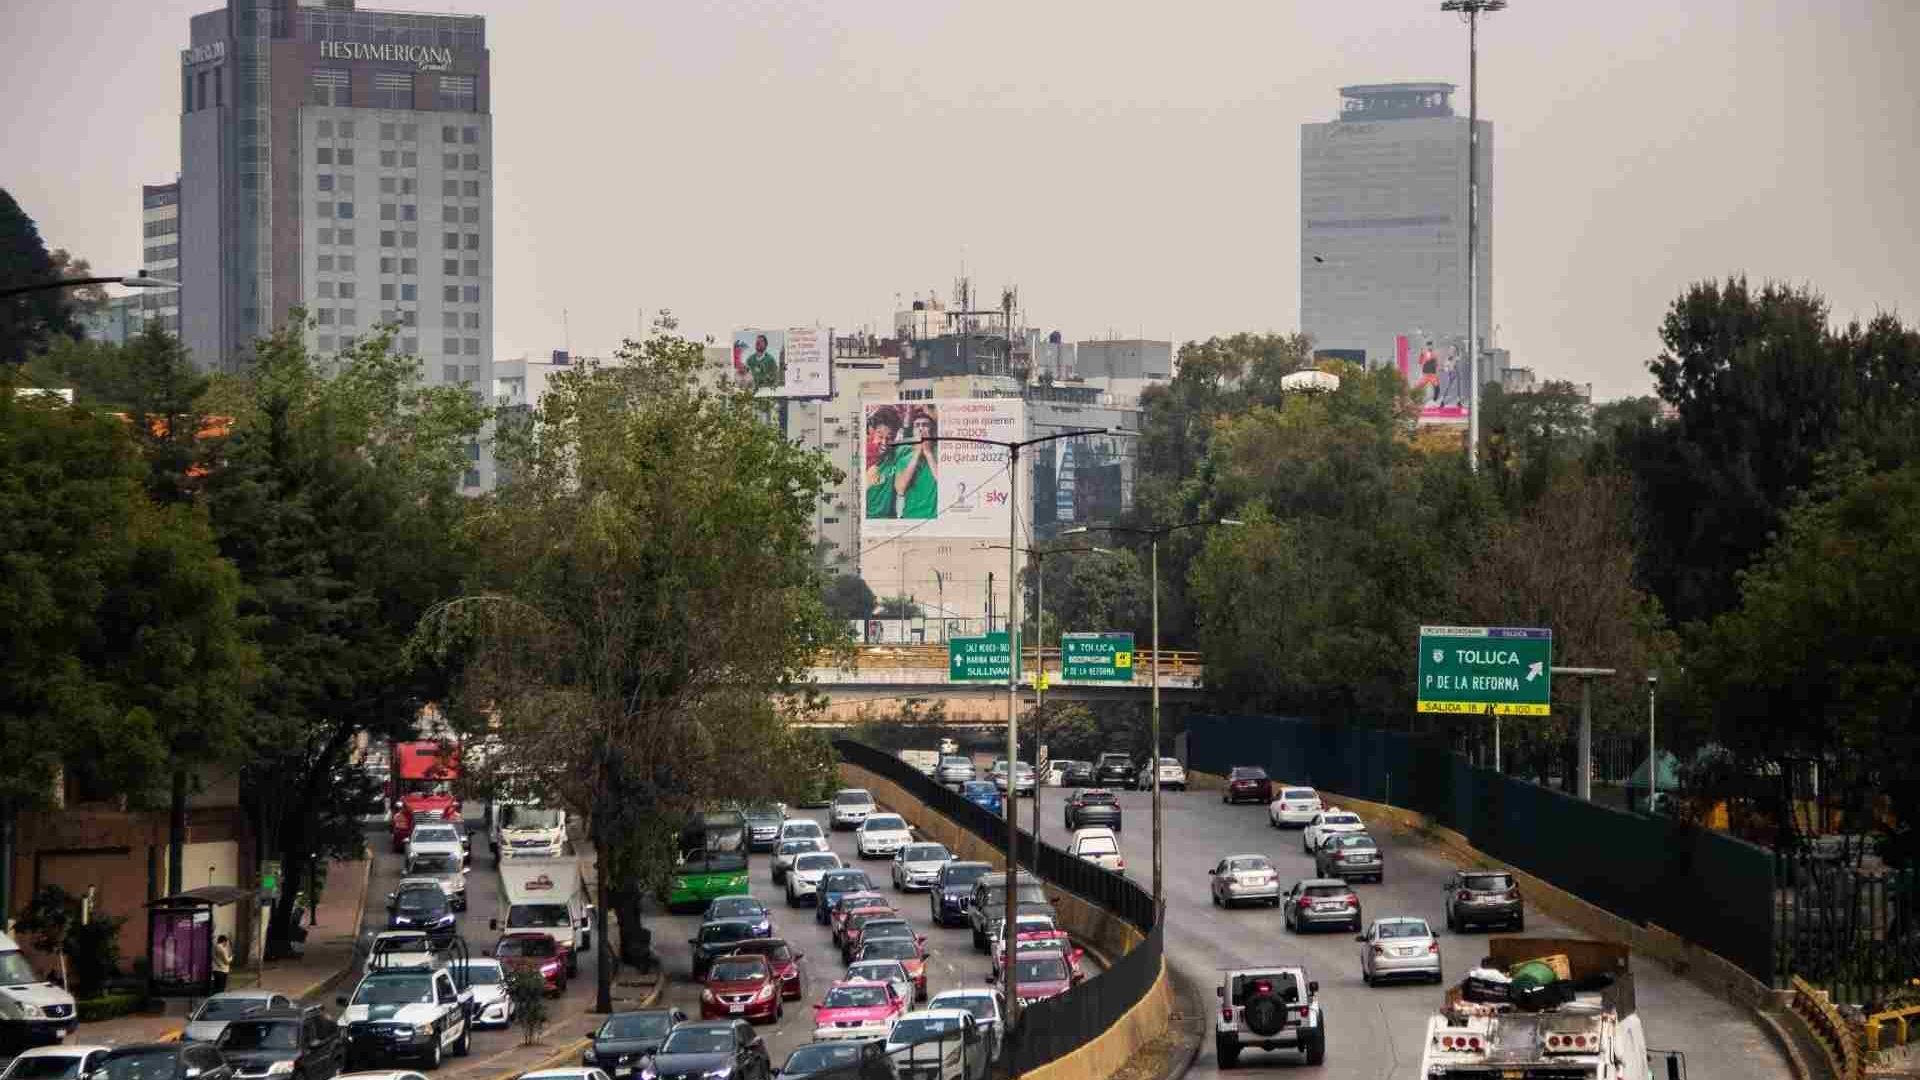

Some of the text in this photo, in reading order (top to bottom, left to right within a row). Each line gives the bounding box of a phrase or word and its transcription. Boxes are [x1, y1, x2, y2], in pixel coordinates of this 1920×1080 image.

[320, 40, 452, 64] FIESTAMERICANA
[985, 488, 1009, 505] sky
[1456, 649, 1520, 665] TOLUCA
[1426, 674, 1520, 692] P DE LA REFORMA
